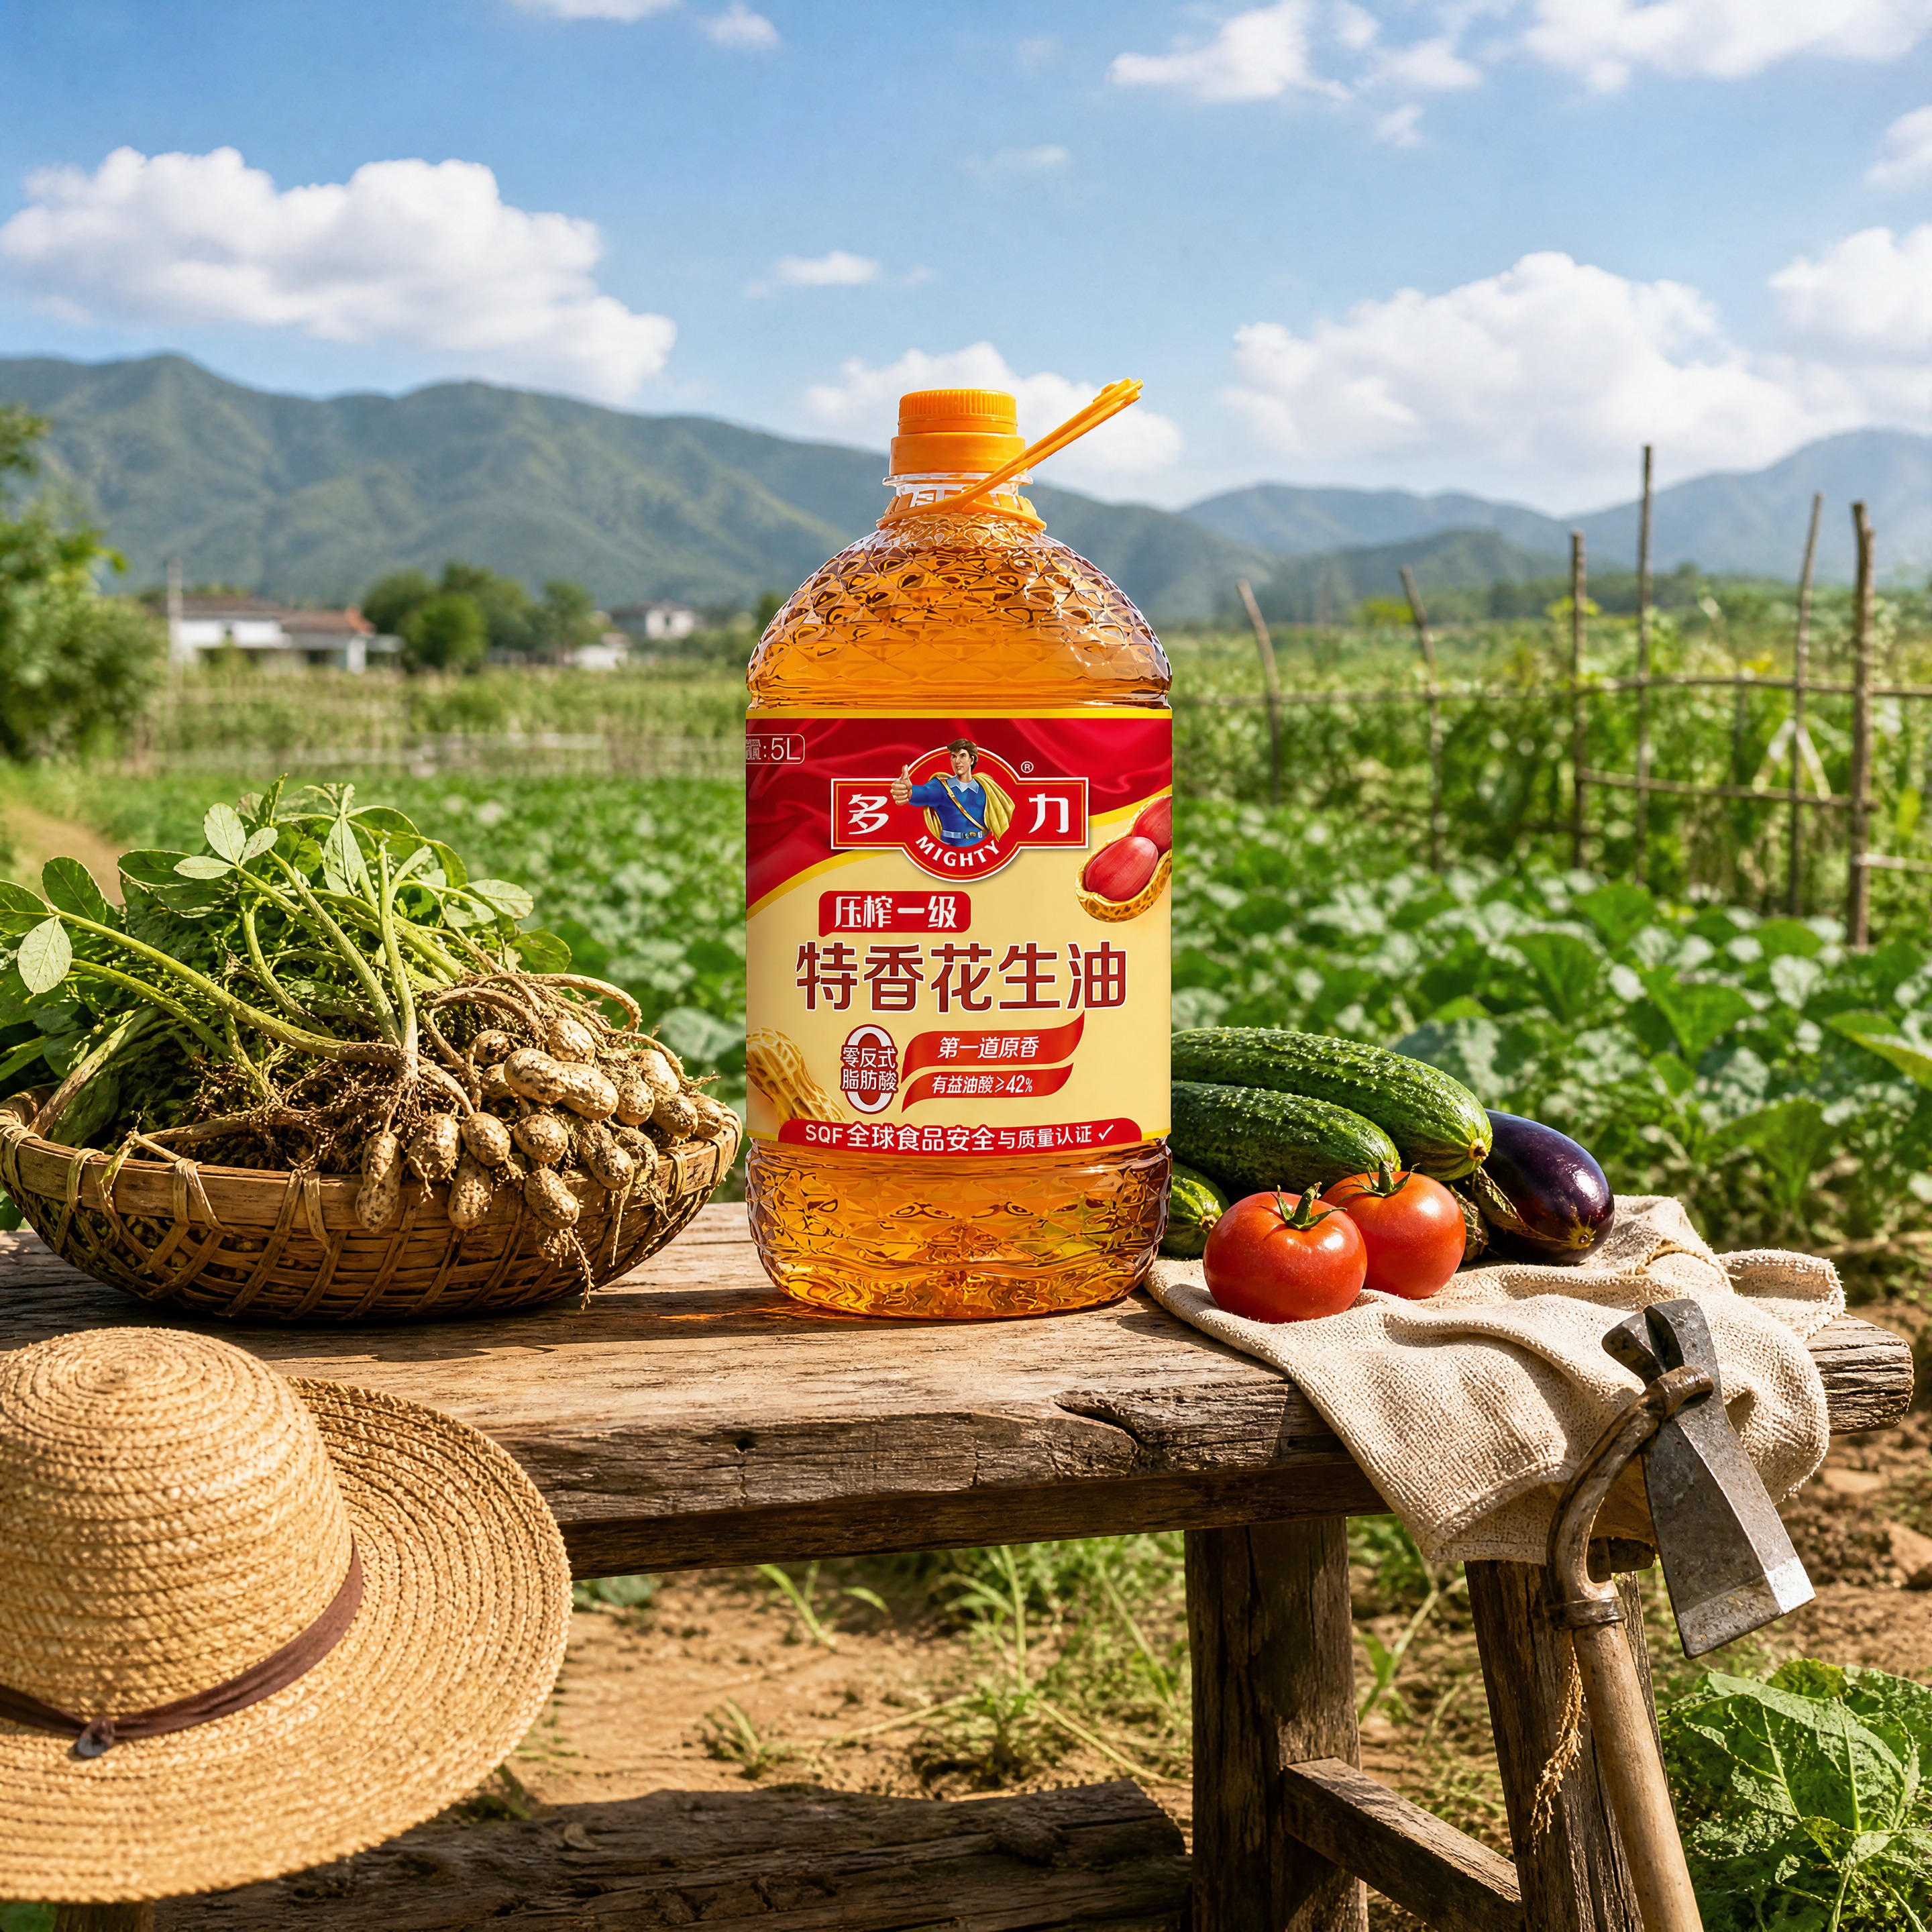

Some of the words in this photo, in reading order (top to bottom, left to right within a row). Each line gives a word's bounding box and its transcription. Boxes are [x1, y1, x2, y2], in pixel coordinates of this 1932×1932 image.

[847, 794, 889, 835] 多
[1028, 793, 1069, 834] 力
[915, 835, 1000, 867] MIGHTY
[835, 895, 957, 928] 压榨一级
[796, 941, 1126, 1012] 特香花生油
[937, 1036, 1040, 1059] 第一道原香
